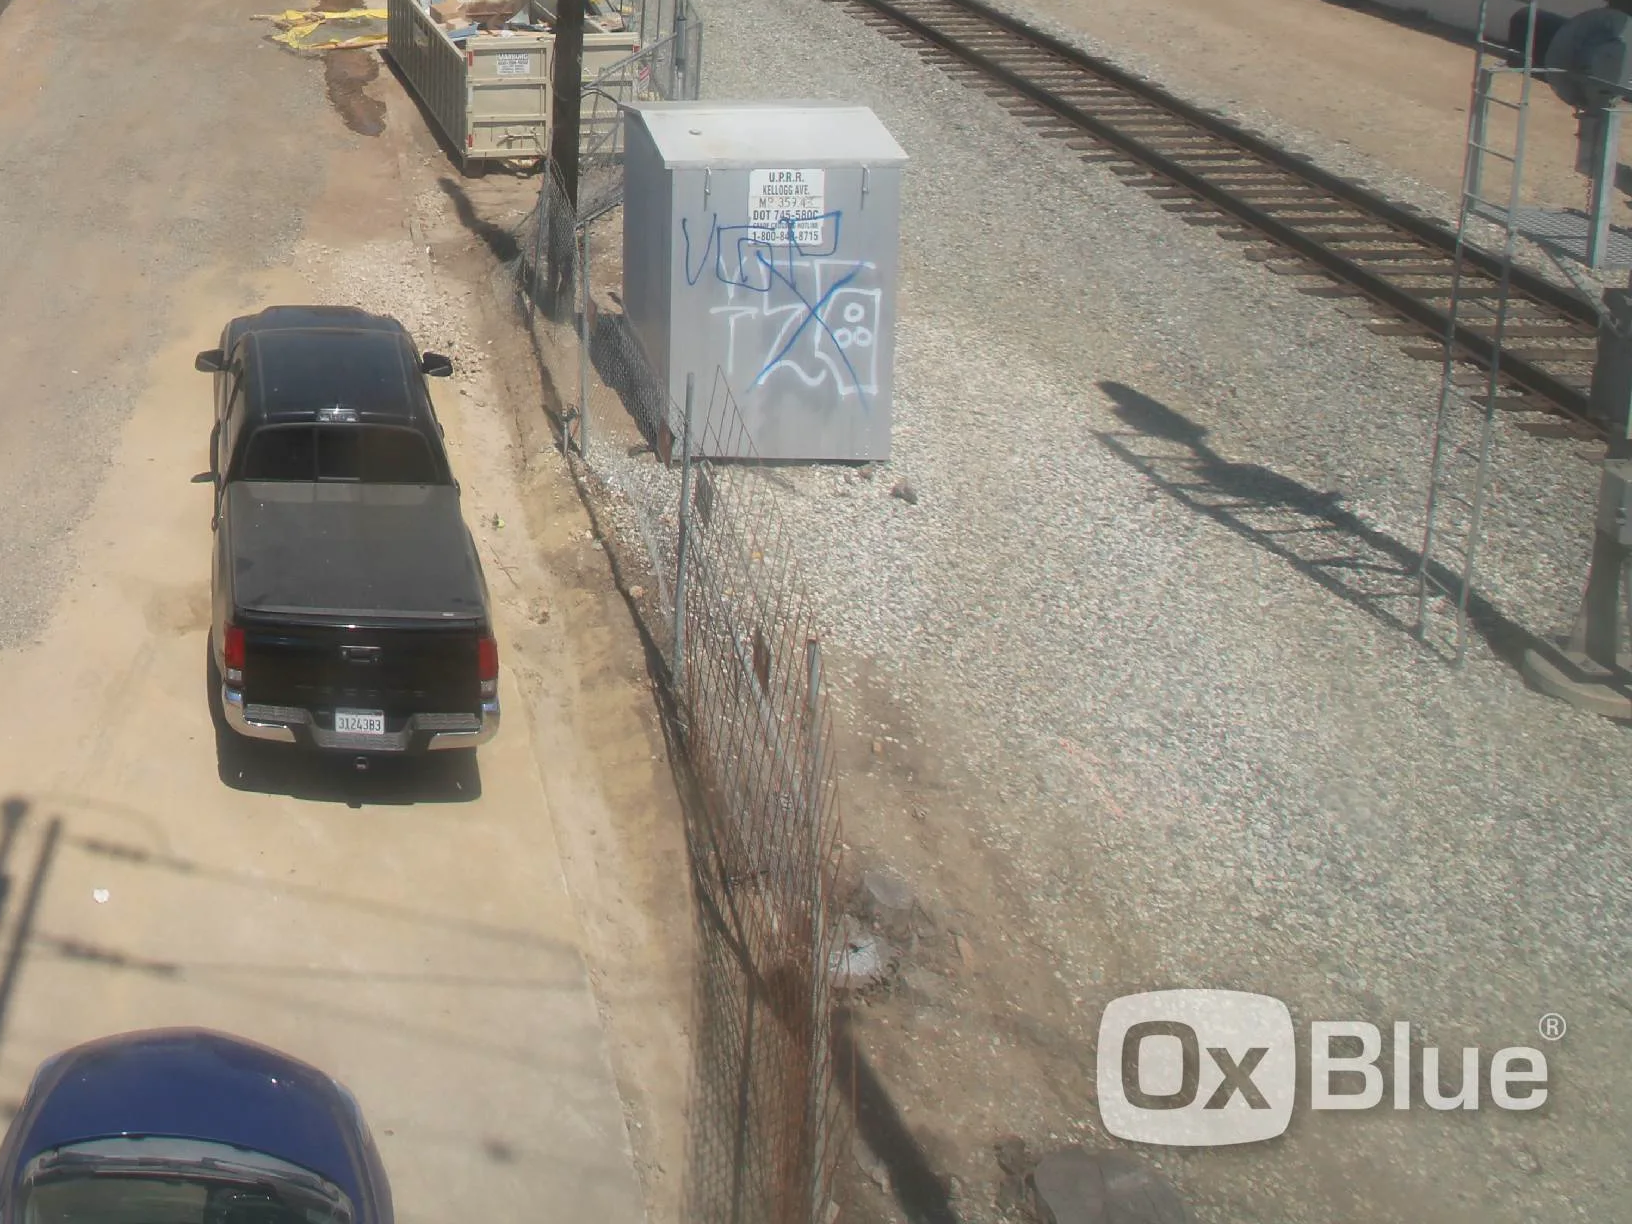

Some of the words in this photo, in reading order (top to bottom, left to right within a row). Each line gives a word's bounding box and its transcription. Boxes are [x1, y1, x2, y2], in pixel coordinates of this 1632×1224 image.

[769, 172, 805, 183] U.P.R.R.
[762, 184, 793, 196] KELLOGG
[794, 184, 810, 196] AVE.
[753, 210, 771, 221] DOT
